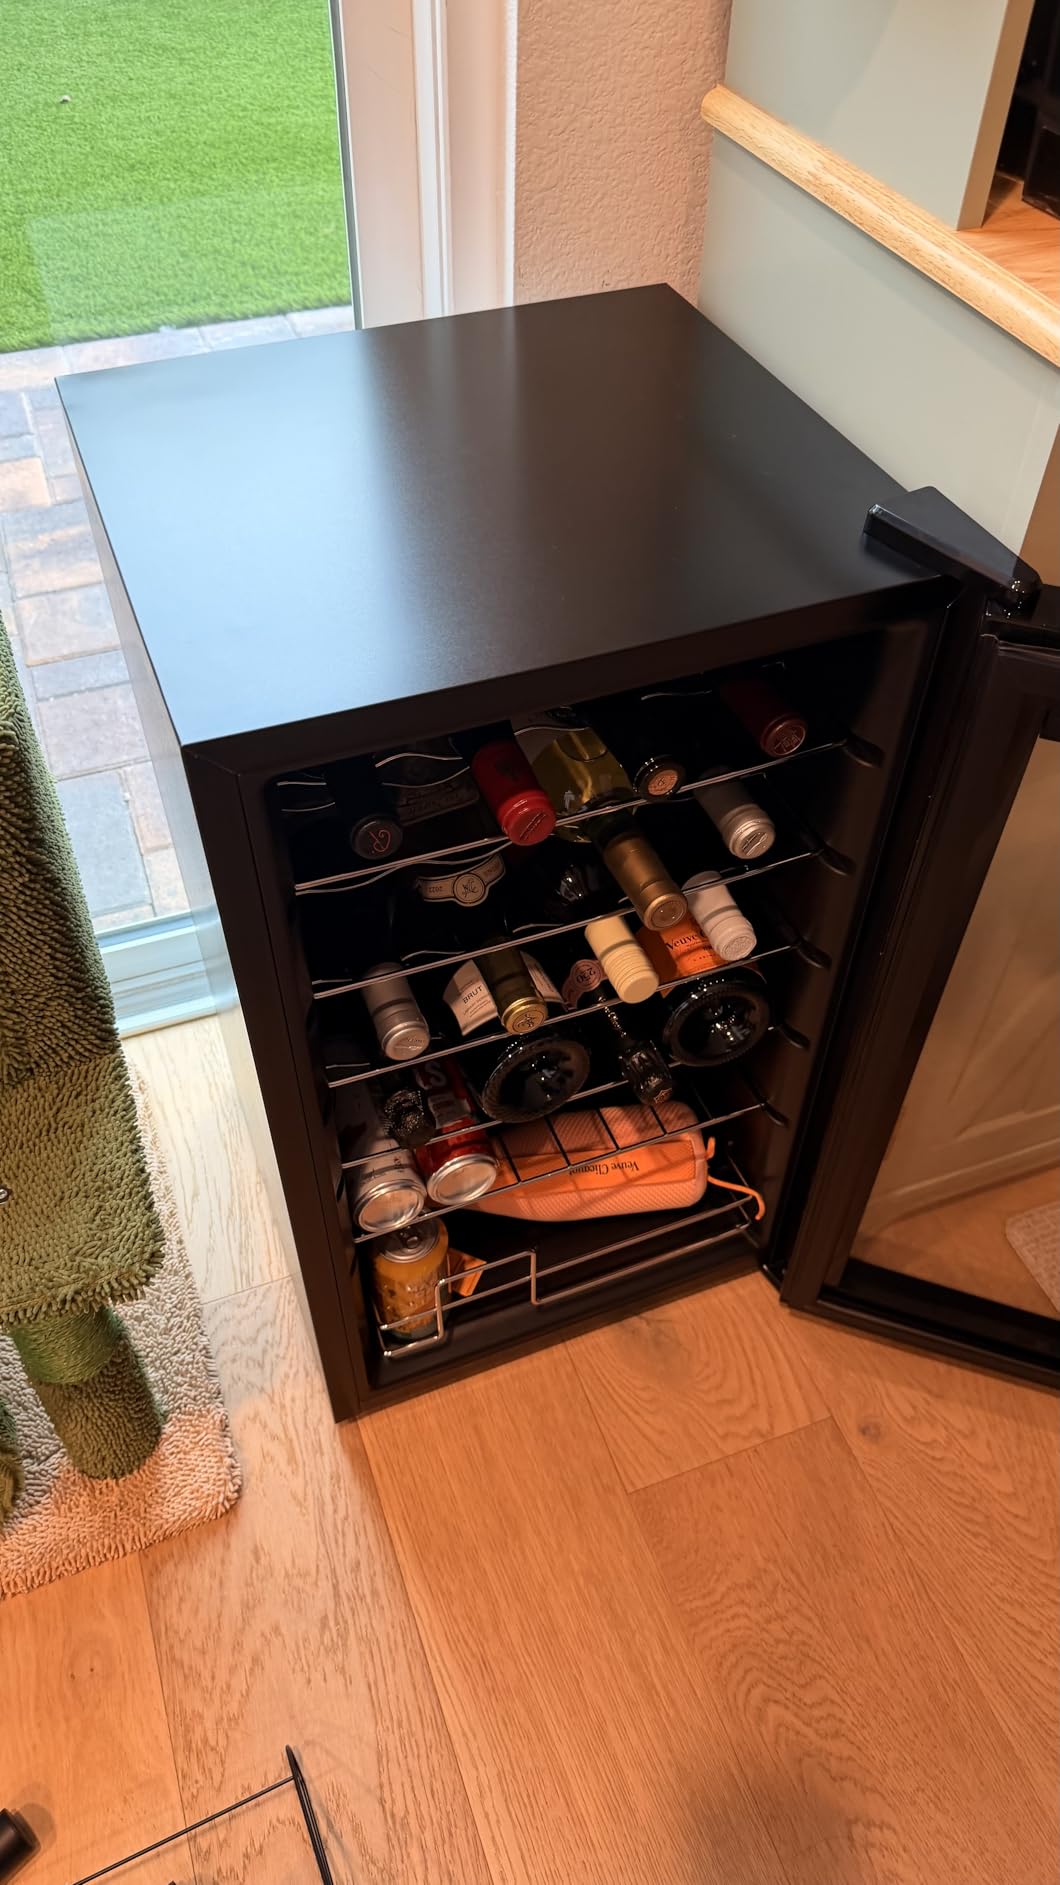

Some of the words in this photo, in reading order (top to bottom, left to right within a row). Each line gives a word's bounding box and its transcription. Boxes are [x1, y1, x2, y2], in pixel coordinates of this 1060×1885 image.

[665, 933, 698, 950] Veuve
[576, 967, 596, 984] 250
[462, 985, 483, 1004] BRUT
[611, 1161, 640, 1172] Veuve
